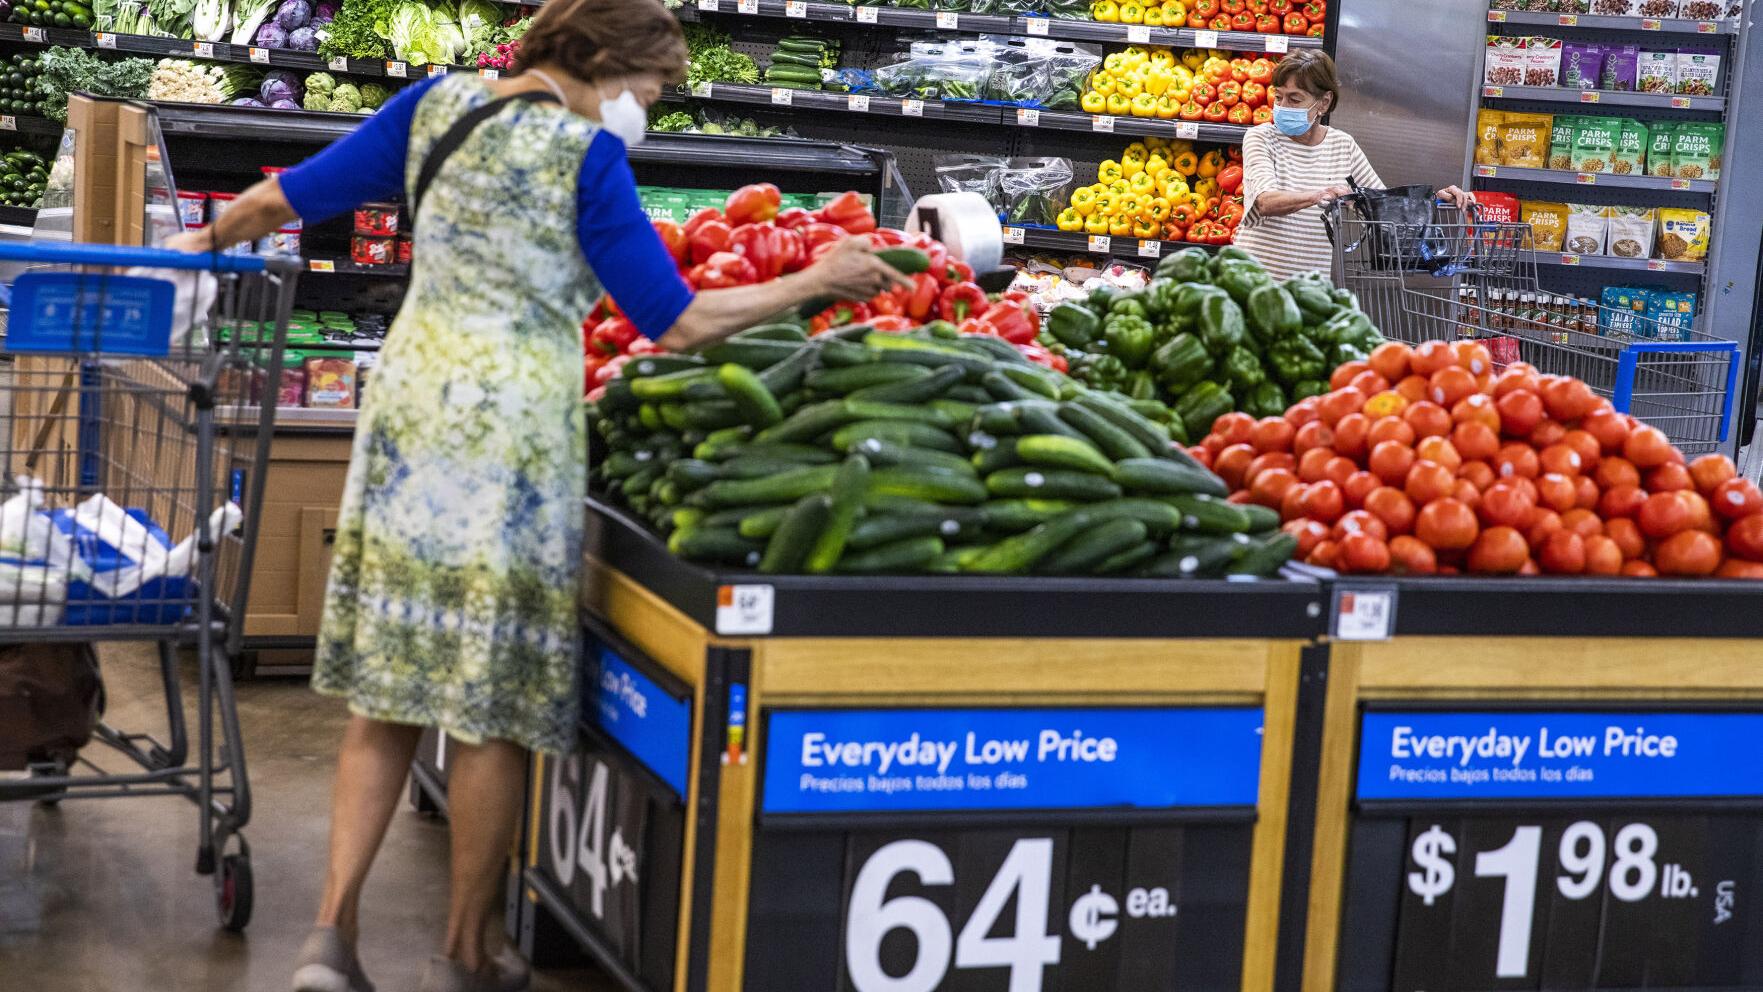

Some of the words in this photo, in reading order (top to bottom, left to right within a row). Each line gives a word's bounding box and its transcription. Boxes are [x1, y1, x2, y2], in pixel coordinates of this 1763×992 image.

[1553, 126, 1571, 134] PAR
[1581, 130, 1610, 138] PARM
[1505, 133, 1537, 142] CRISPS
[1621, 132, 1638, 140] RM
[1679, 135, 1709, 143] PARM
[1577, 137, 1613, 147] CRISPS
[1675, 143, 1711, 153] CRISPS
[1484, 207, 1510, 215] PARM
[1528, 218, 1560, 228] CRISPS
[1658, 316, 1681, 327] SALAD
[1391, 726, 1531, 766] Everyday
[1538, 727, 1596, 758] Low
[1603, 726, 1678, 758] Price
[802, 733, 957, 776] Everyday
[965, 731, 1029, 764] Low
[1037, 730, 1118, 762] Price
[1389, 764, 1446, 782] Precios
[1450, 765, 1490, 785] bajos
[1492, 766, 1537, 781] todos
[1540, 766, 1562, 781] los
[1565, 765, 1594, 782] días
[800, 773, 864, 792] Precios
[867, 775, 912, 794] bajos
[915, 774, 964, 790] todos
[967, 774, 991, 790] los
[1661, 863, 1699, 898] lb.
[1126, 888, 1177, 918] ea.
[1714, 880, 1735, 924] USA
